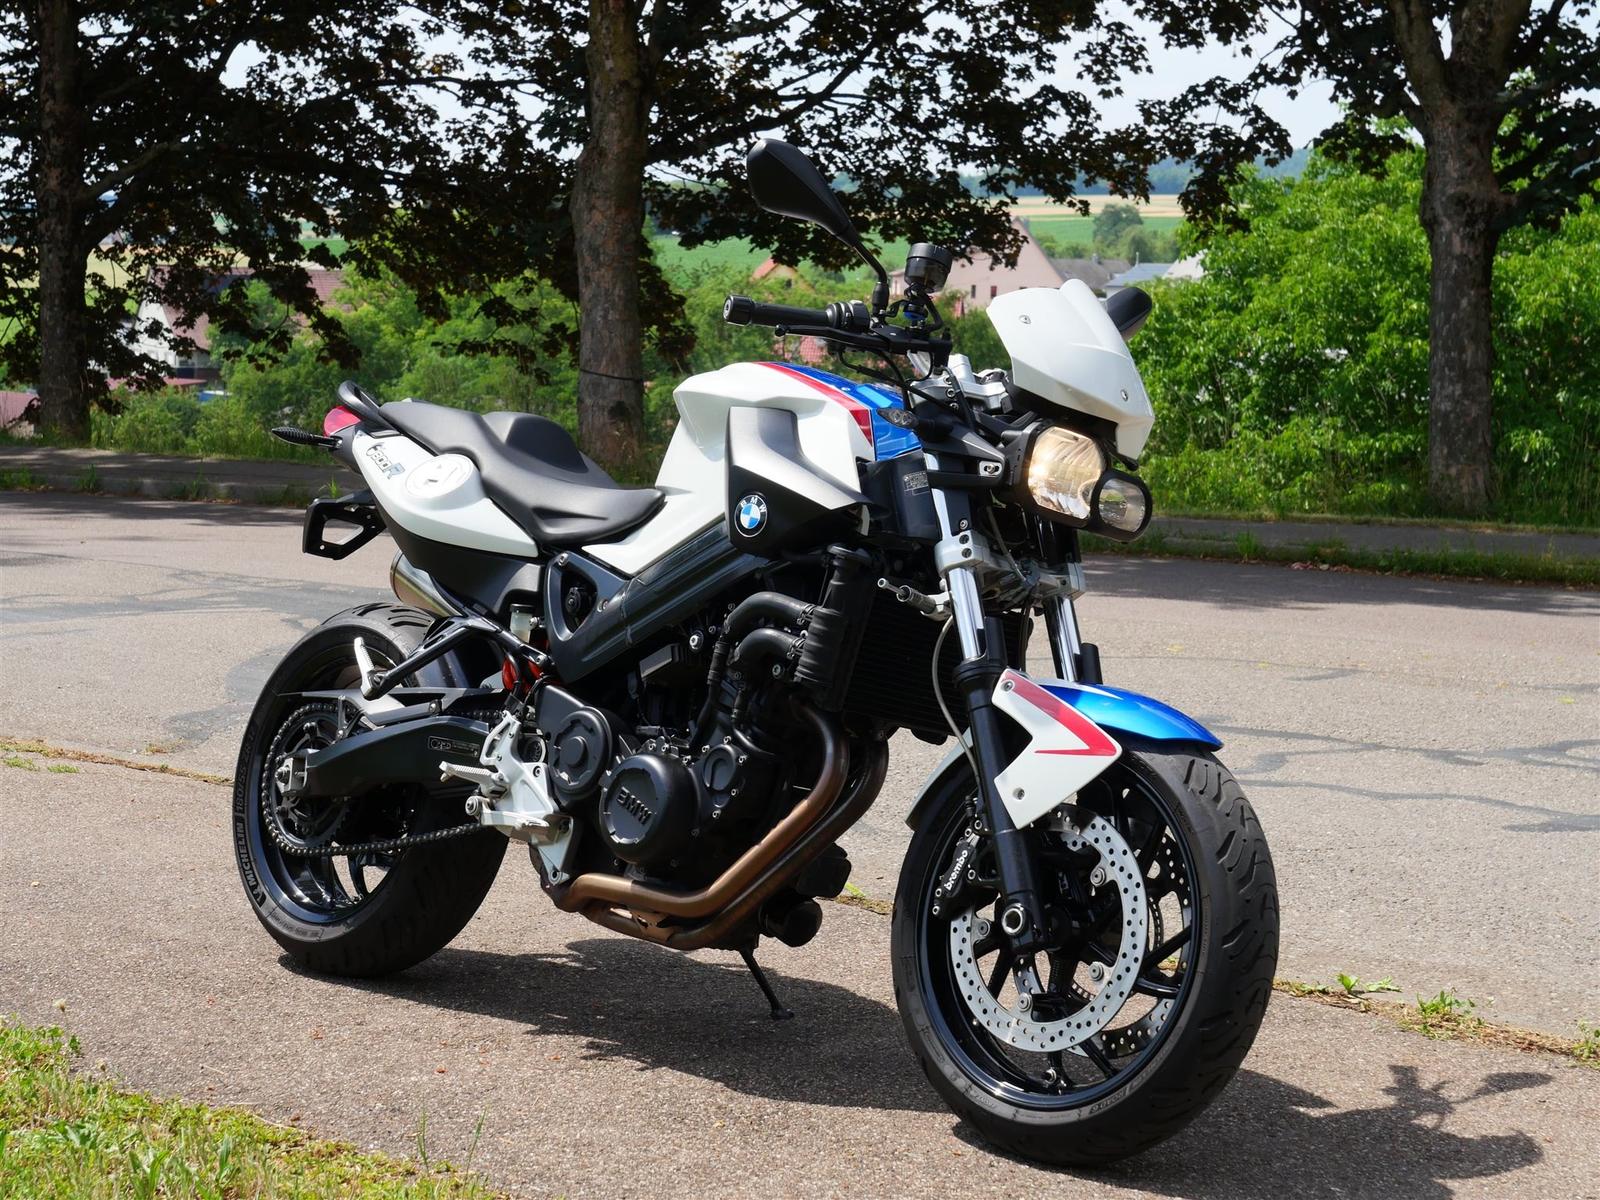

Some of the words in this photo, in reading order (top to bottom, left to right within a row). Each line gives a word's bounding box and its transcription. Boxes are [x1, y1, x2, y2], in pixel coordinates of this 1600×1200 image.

[617, 786, 653, 826] BMW
[236, 822, 259, 887] MICHELIN
[943, 849, 968, 891] brembo
